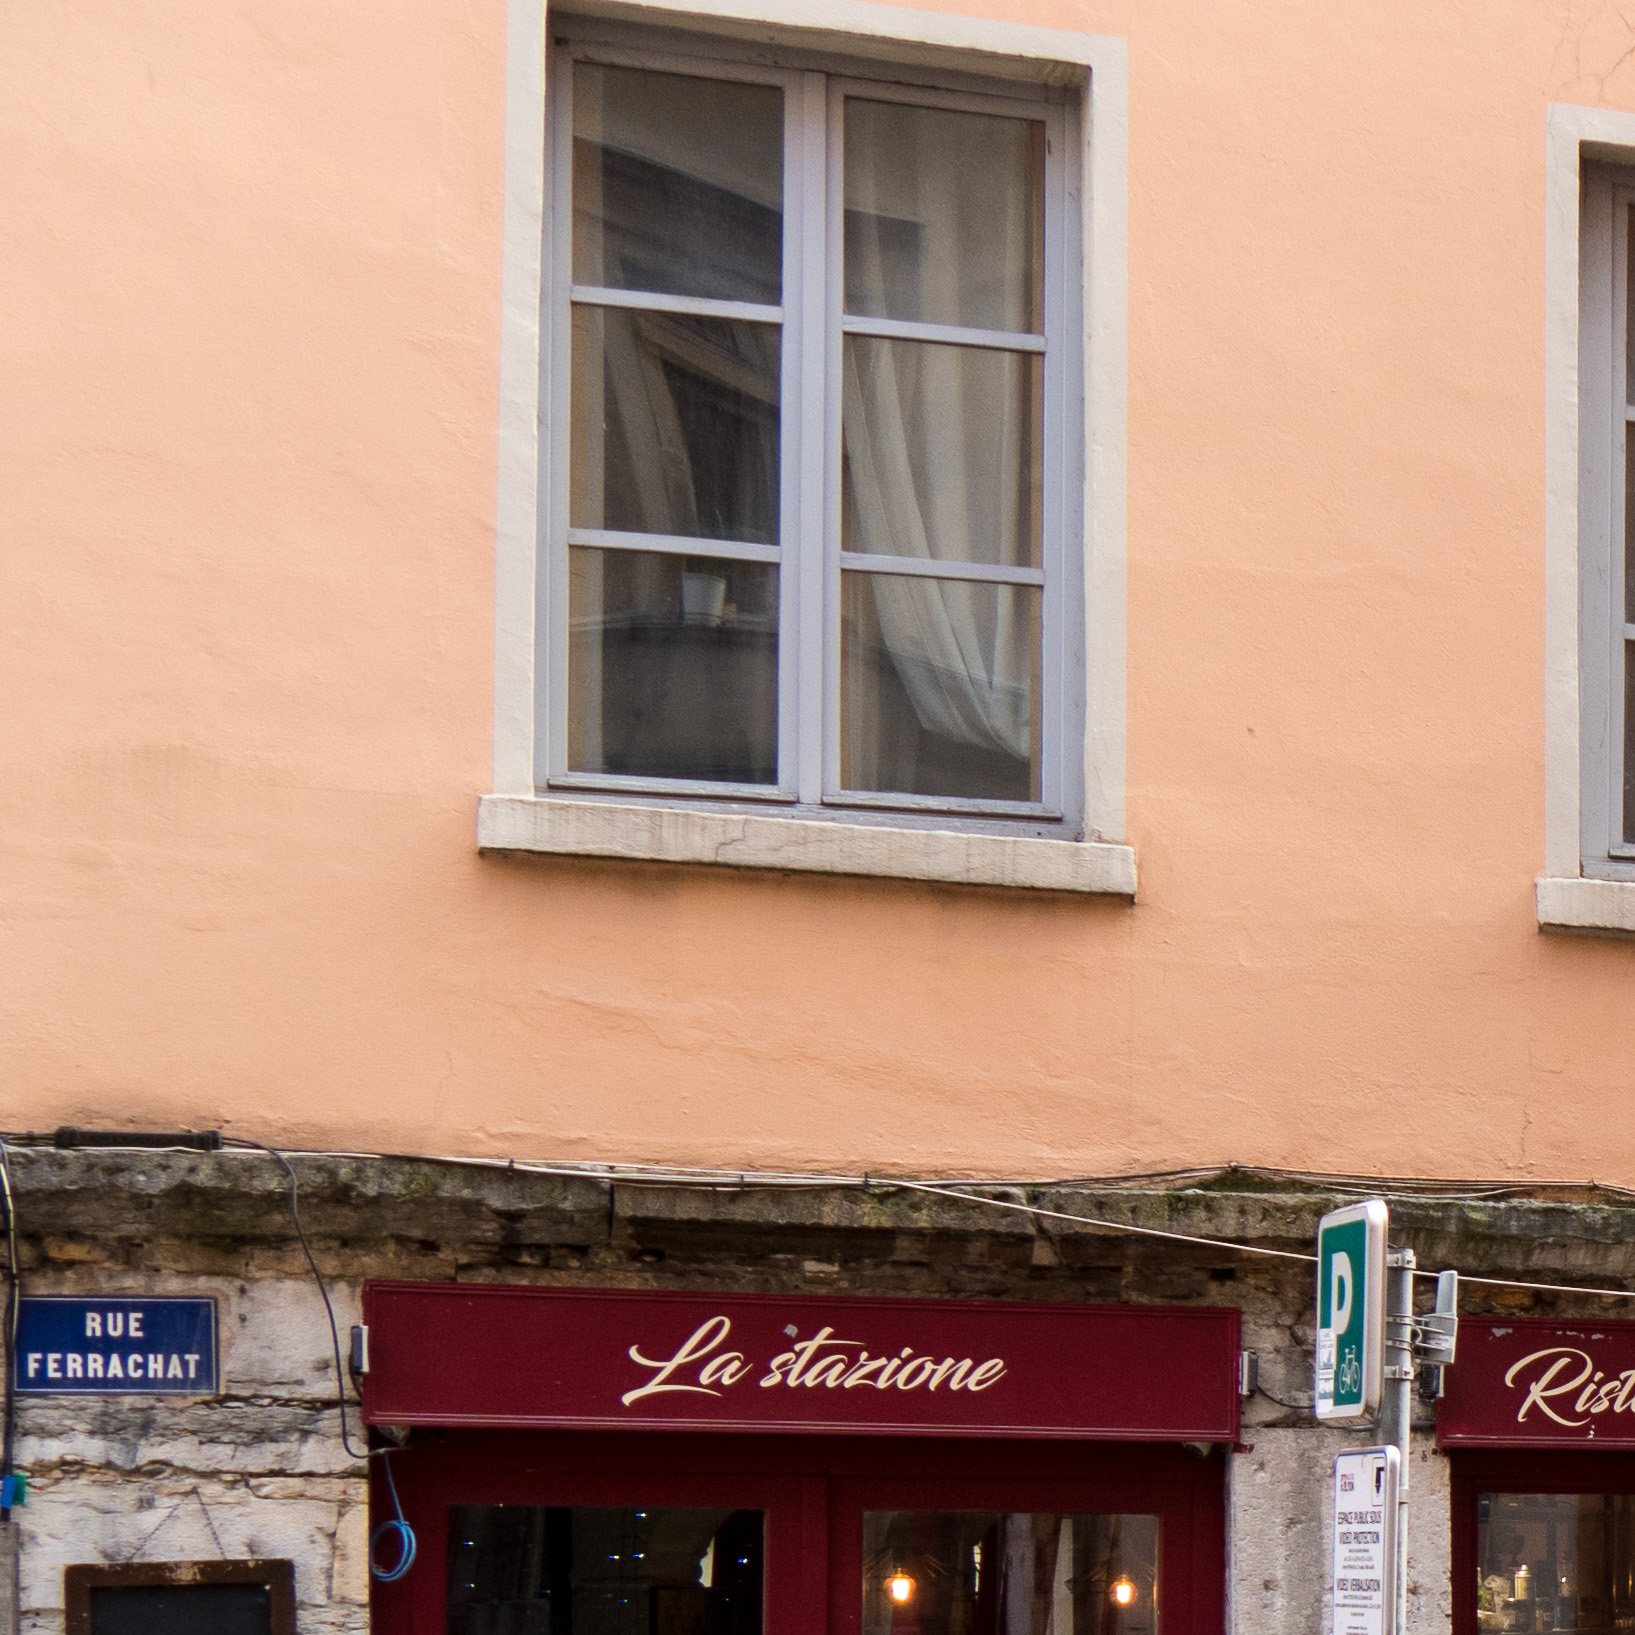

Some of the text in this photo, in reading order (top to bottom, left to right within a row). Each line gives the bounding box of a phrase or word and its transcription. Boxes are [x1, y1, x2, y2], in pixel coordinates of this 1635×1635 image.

[85, 1312, 144, 1337] RUE
[27, 1353, 200, 1379] FERRACHAT
[621, 1315, 1007, 1407] La stazione
